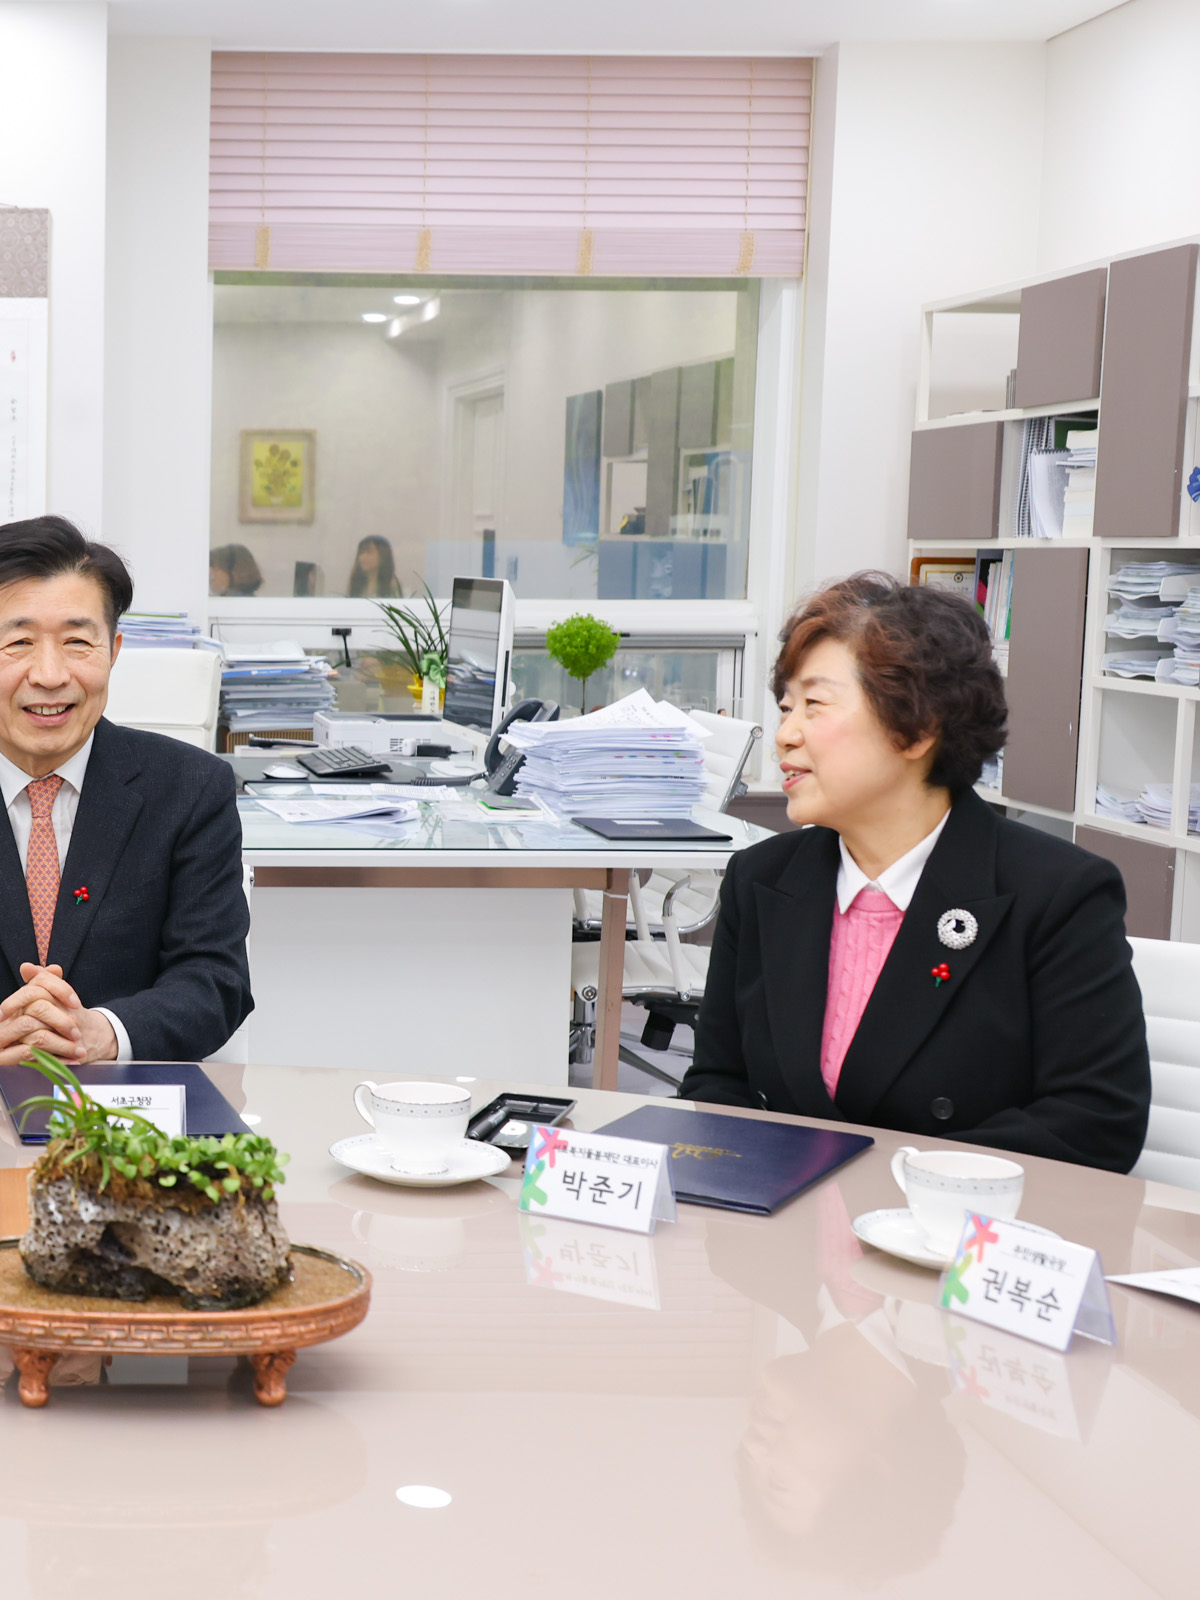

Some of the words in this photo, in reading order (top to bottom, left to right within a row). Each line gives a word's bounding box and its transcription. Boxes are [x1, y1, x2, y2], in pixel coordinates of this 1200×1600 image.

[111, 1096, 152, 1106] 서초구청장
[623, 1155, 659, 1168] 대표이사
[562, 1170, 642, 1210] 박준기
[982, 1268, 1061, 1322] 권복순
